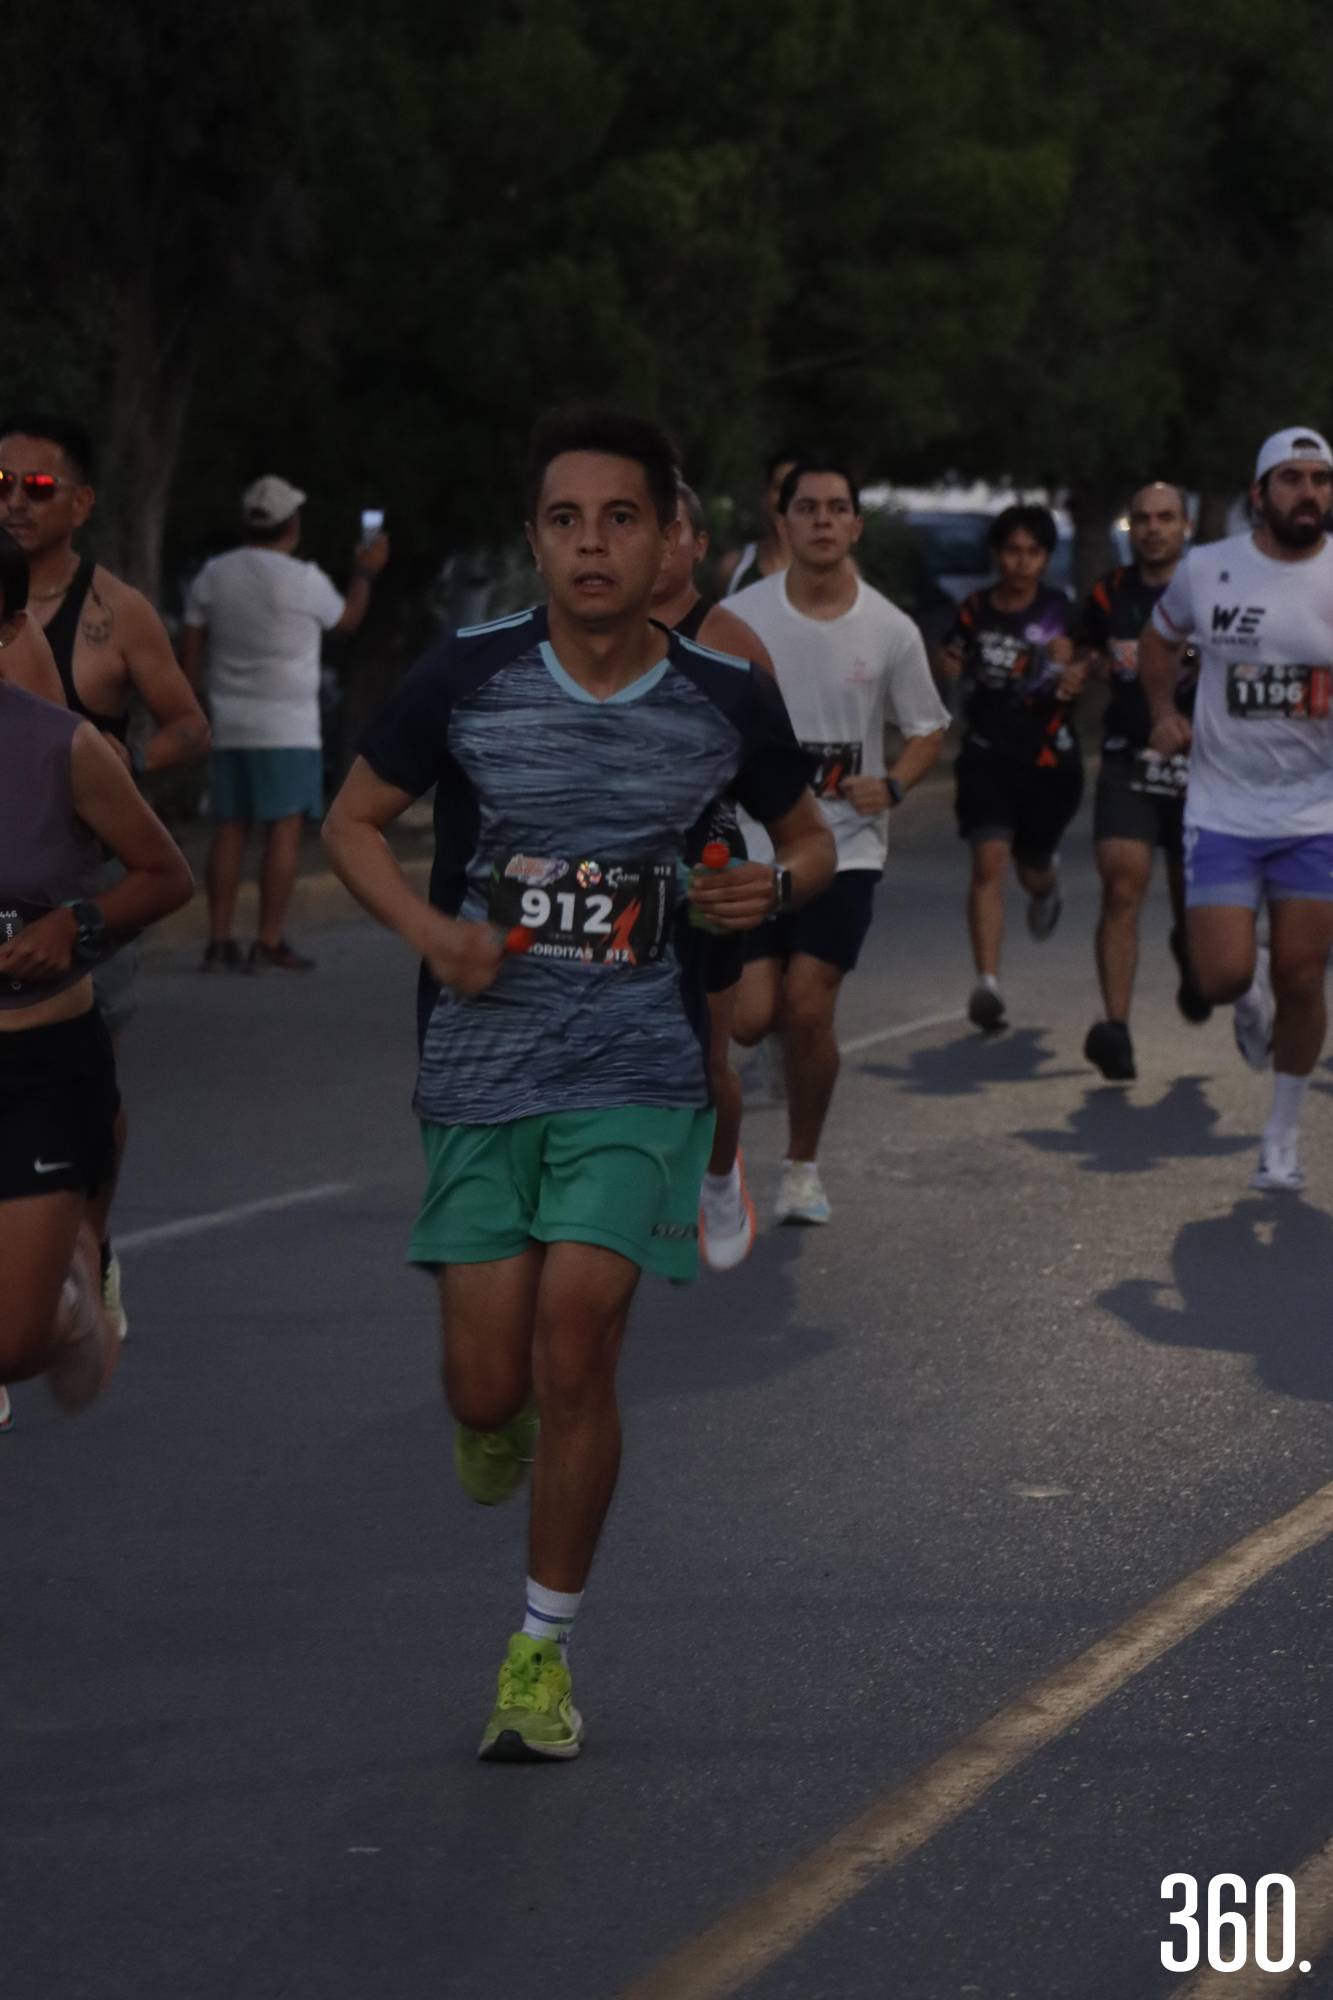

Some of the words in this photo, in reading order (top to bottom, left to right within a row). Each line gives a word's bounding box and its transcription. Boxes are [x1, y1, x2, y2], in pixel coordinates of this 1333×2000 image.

[1212, 605, 1265, 633] WE
[1236, 681, 1303, 704] 1196
[520, 888, 613, 934] 912
